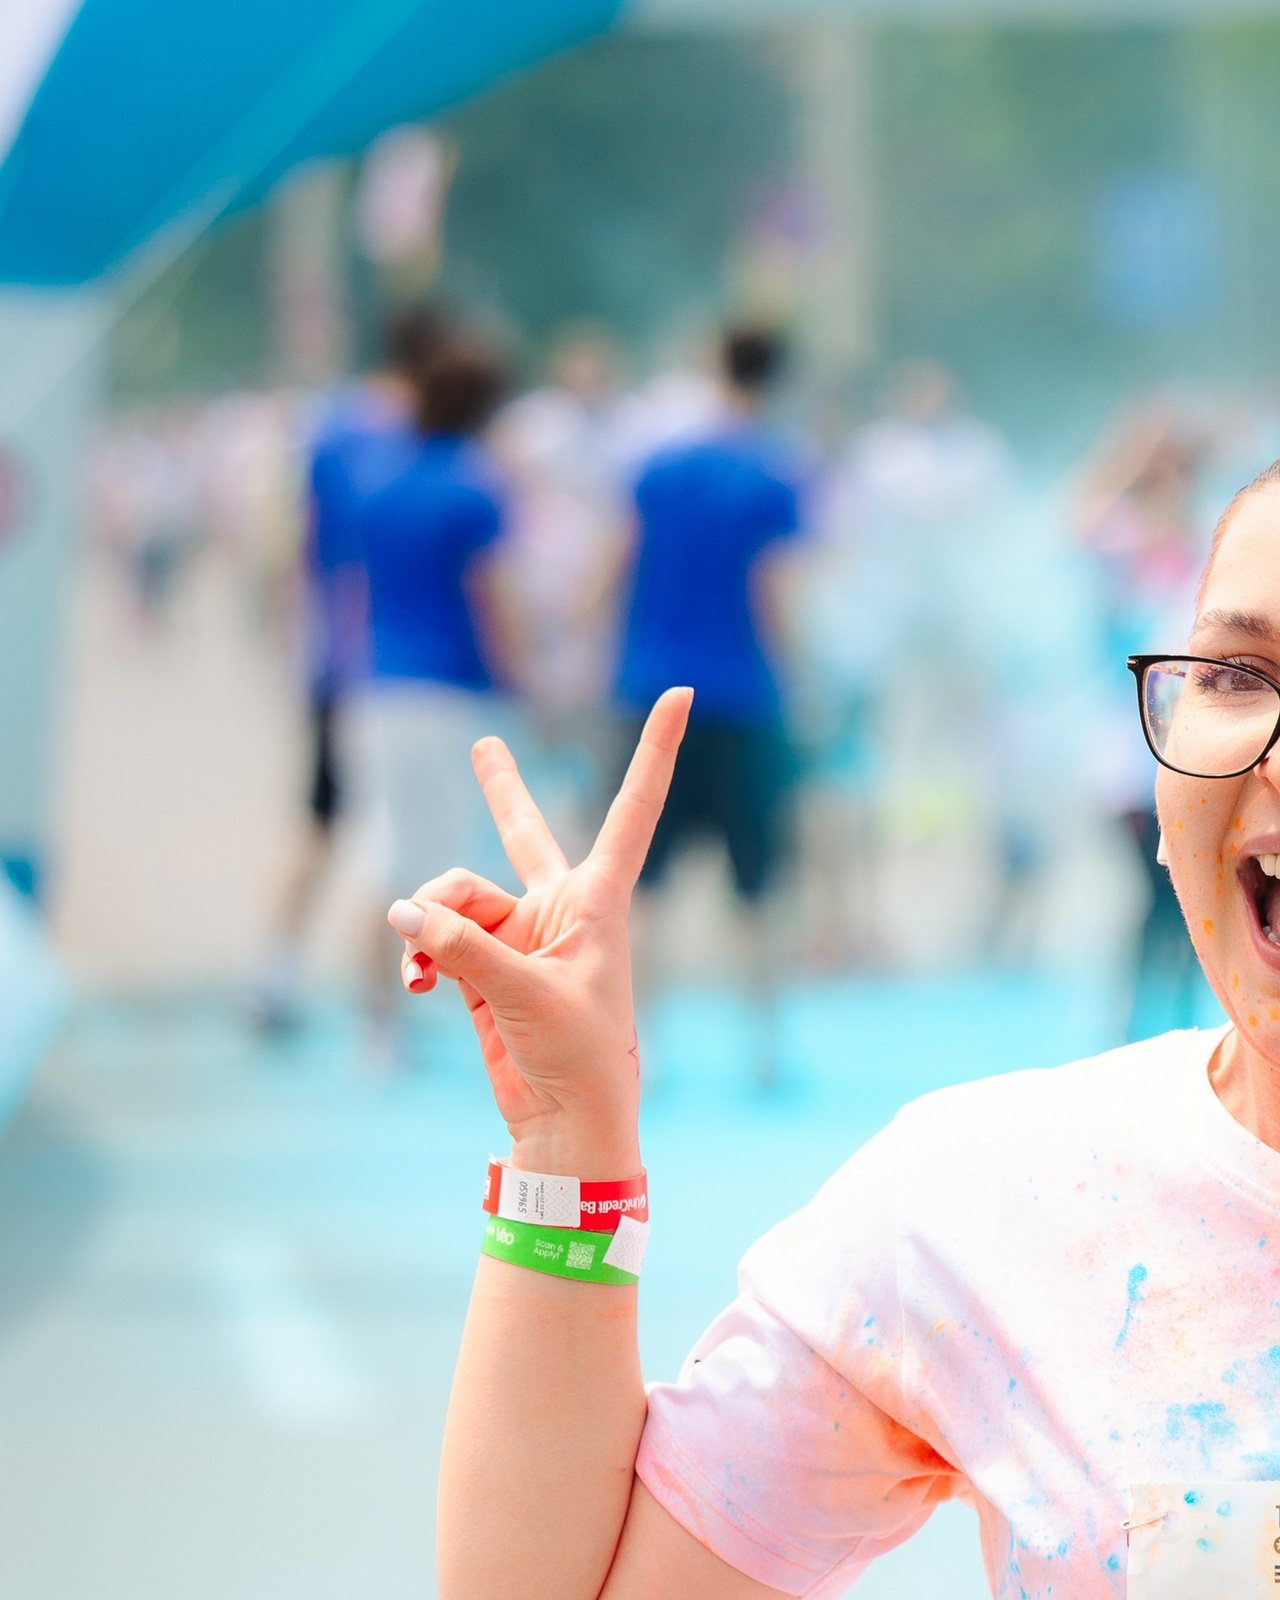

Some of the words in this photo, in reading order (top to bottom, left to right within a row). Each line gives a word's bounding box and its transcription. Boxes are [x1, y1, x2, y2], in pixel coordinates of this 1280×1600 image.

[580, 1200, 597, 1214] Ba
[598, 1196, 640, 1214] UniCredit
[535, 1238, 556, 1250] Scan
[557, 1244, 564, 1252] &
[533, 1247, 560, 1260] Apply!
